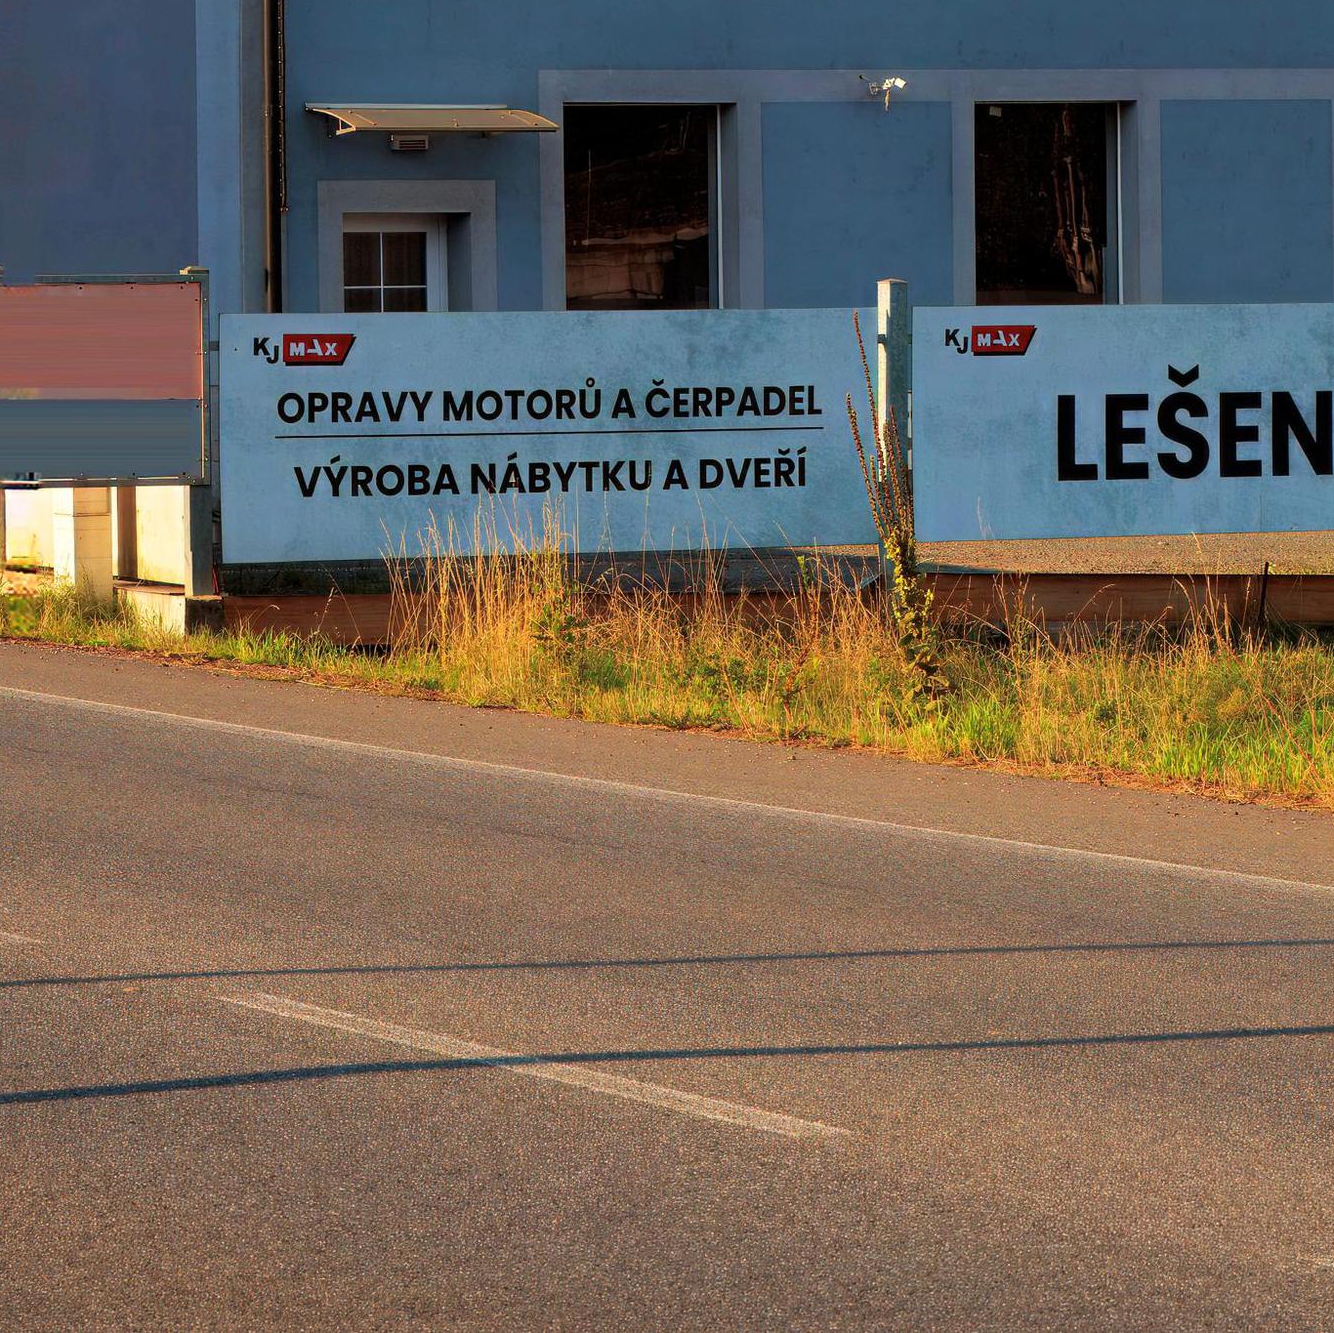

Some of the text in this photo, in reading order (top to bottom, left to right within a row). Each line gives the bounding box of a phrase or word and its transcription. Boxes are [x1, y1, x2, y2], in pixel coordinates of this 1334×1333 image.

[253, 337, 338, 364] KJ MAX
[944, 328, 1020, 355] KJ MAX
[277, 377, 823, 424] OPRAVY MOTORŮ A ČERPADEL
[294, 446, 807, 498] VÝROBA NÁBYTKU A DVEŘÍ
